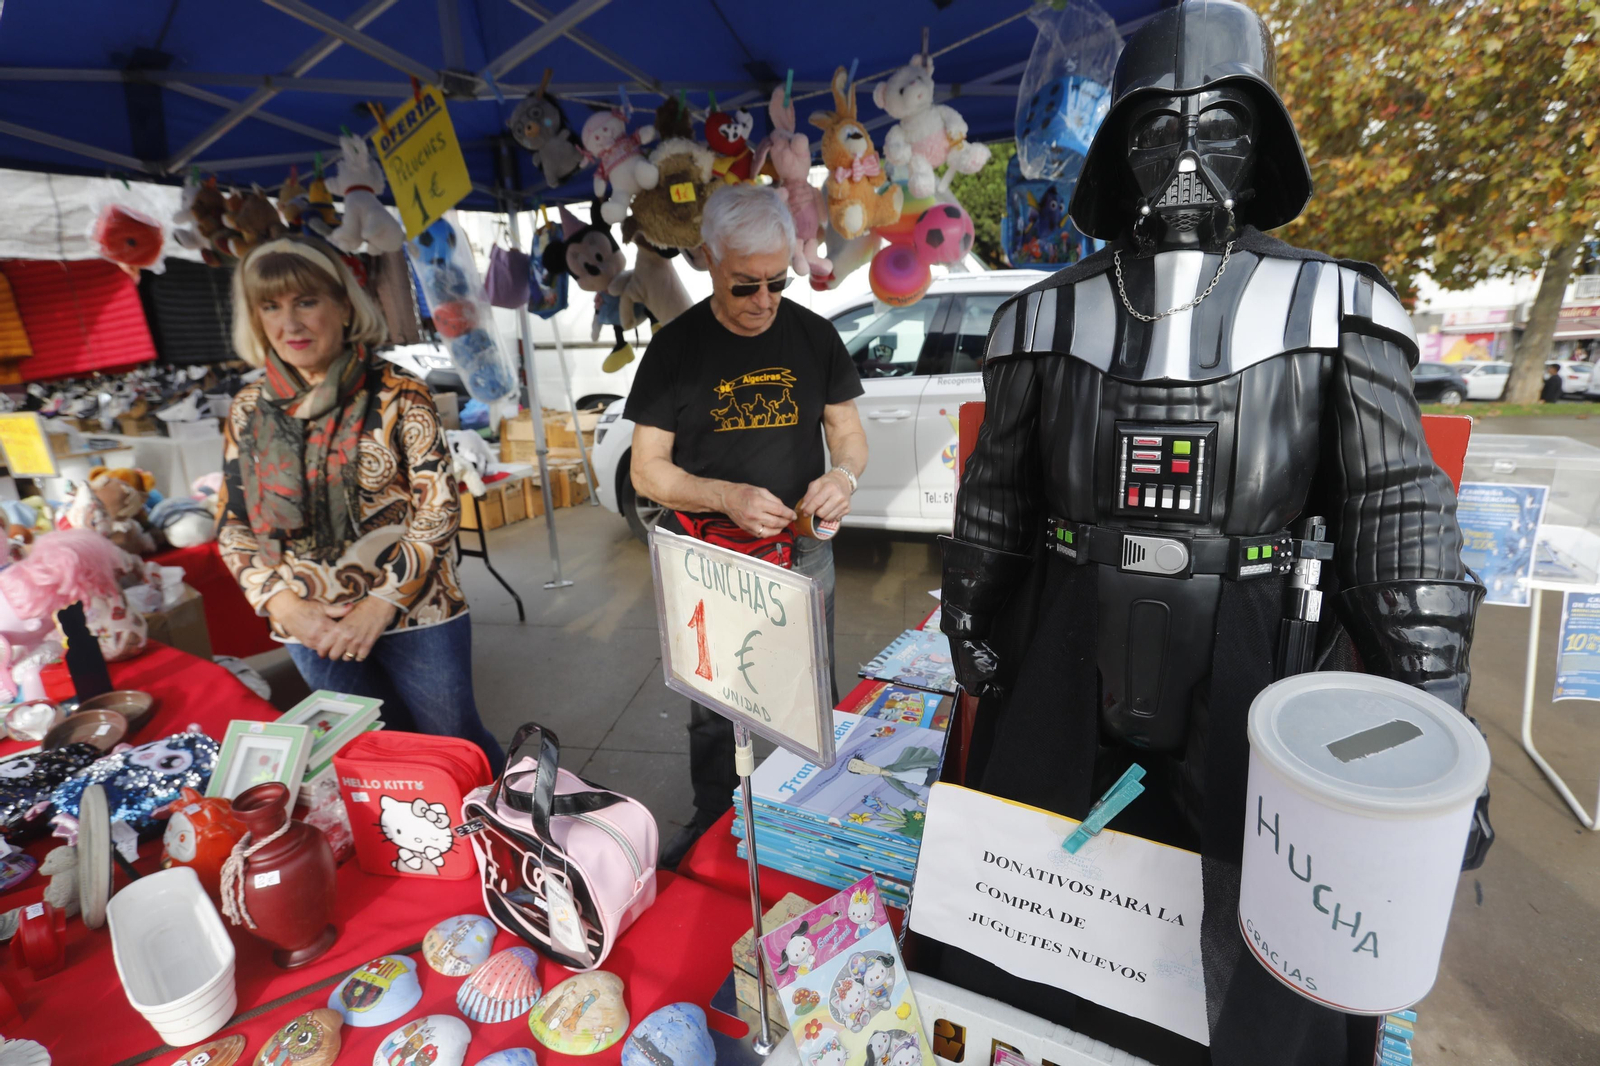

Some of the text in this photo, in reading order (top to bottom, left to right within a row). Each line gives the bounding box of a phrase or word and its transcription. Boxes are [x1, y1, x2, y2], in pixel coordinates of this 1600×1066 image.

[380, 93, 437, 152] OFERTA
[413, 171, 445, 226] 1 €
[742, 373, 782, 385] Algeciras
[936, 376, 982, 387] Recogemos
[924, 491, 942, 504] Tel.:
[684, 548, 788, 628] CONCHAS
[687, 599, 763, 695] 1 €
[1564, 633, 1588, 652] 10
[722, 686, 773, 723] UNIDAD
[342, 777, 425, 791] HELLO KITTY
[982, 850, 1186, 928] DONATIVOS PARA LA
[1256, 795, 1380, 959] HUCHA
[974, 881, 1087, 931] COMPRA DE
[968, 912, 1063, 955] JUGUETES
[1066, 946, 1148, 985] NUEVOS
[1245, 918, 1319, 992] GRACIAS
